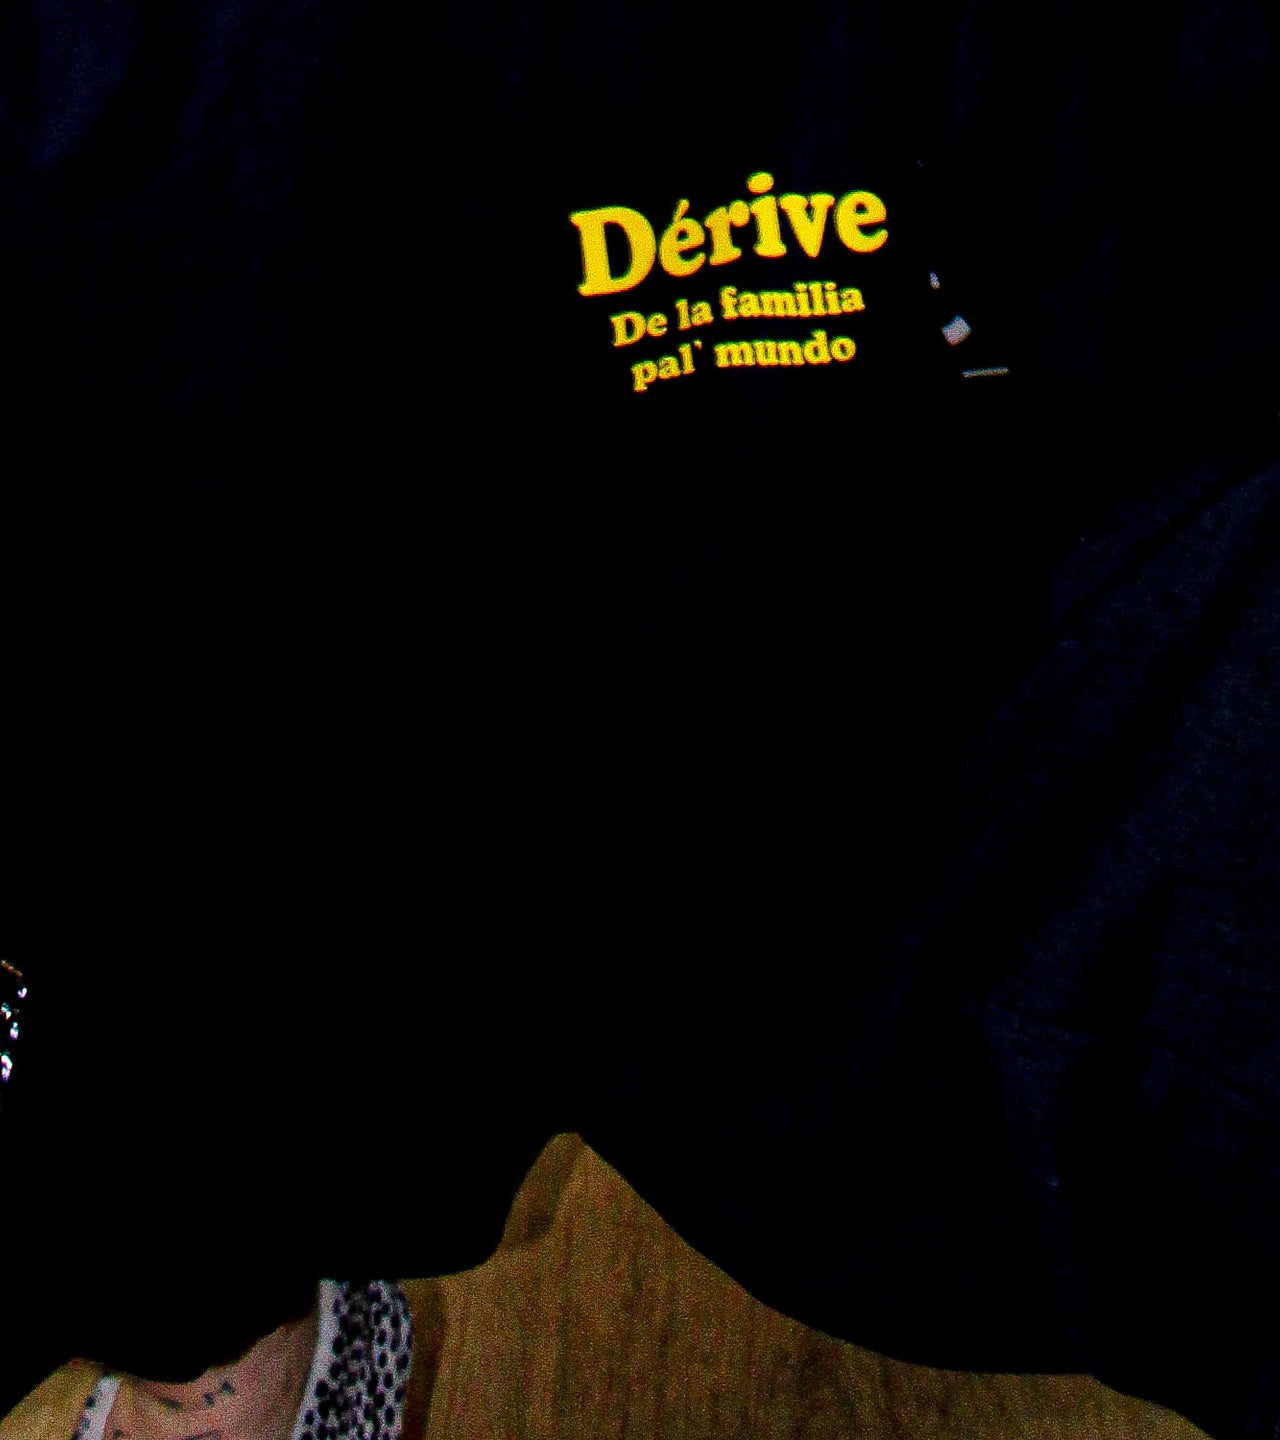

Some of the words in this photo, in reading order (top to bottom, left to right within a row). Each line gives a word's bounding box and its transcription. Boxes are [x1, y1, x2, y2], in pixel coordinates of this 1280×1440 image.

[568, 171, 890, 297] Dérive
[609, 310, 668, 348] De
[675, 297, 715, 331] la
[719, 279, 866, 321] familia
[714, 329, 858, 370] mundo
